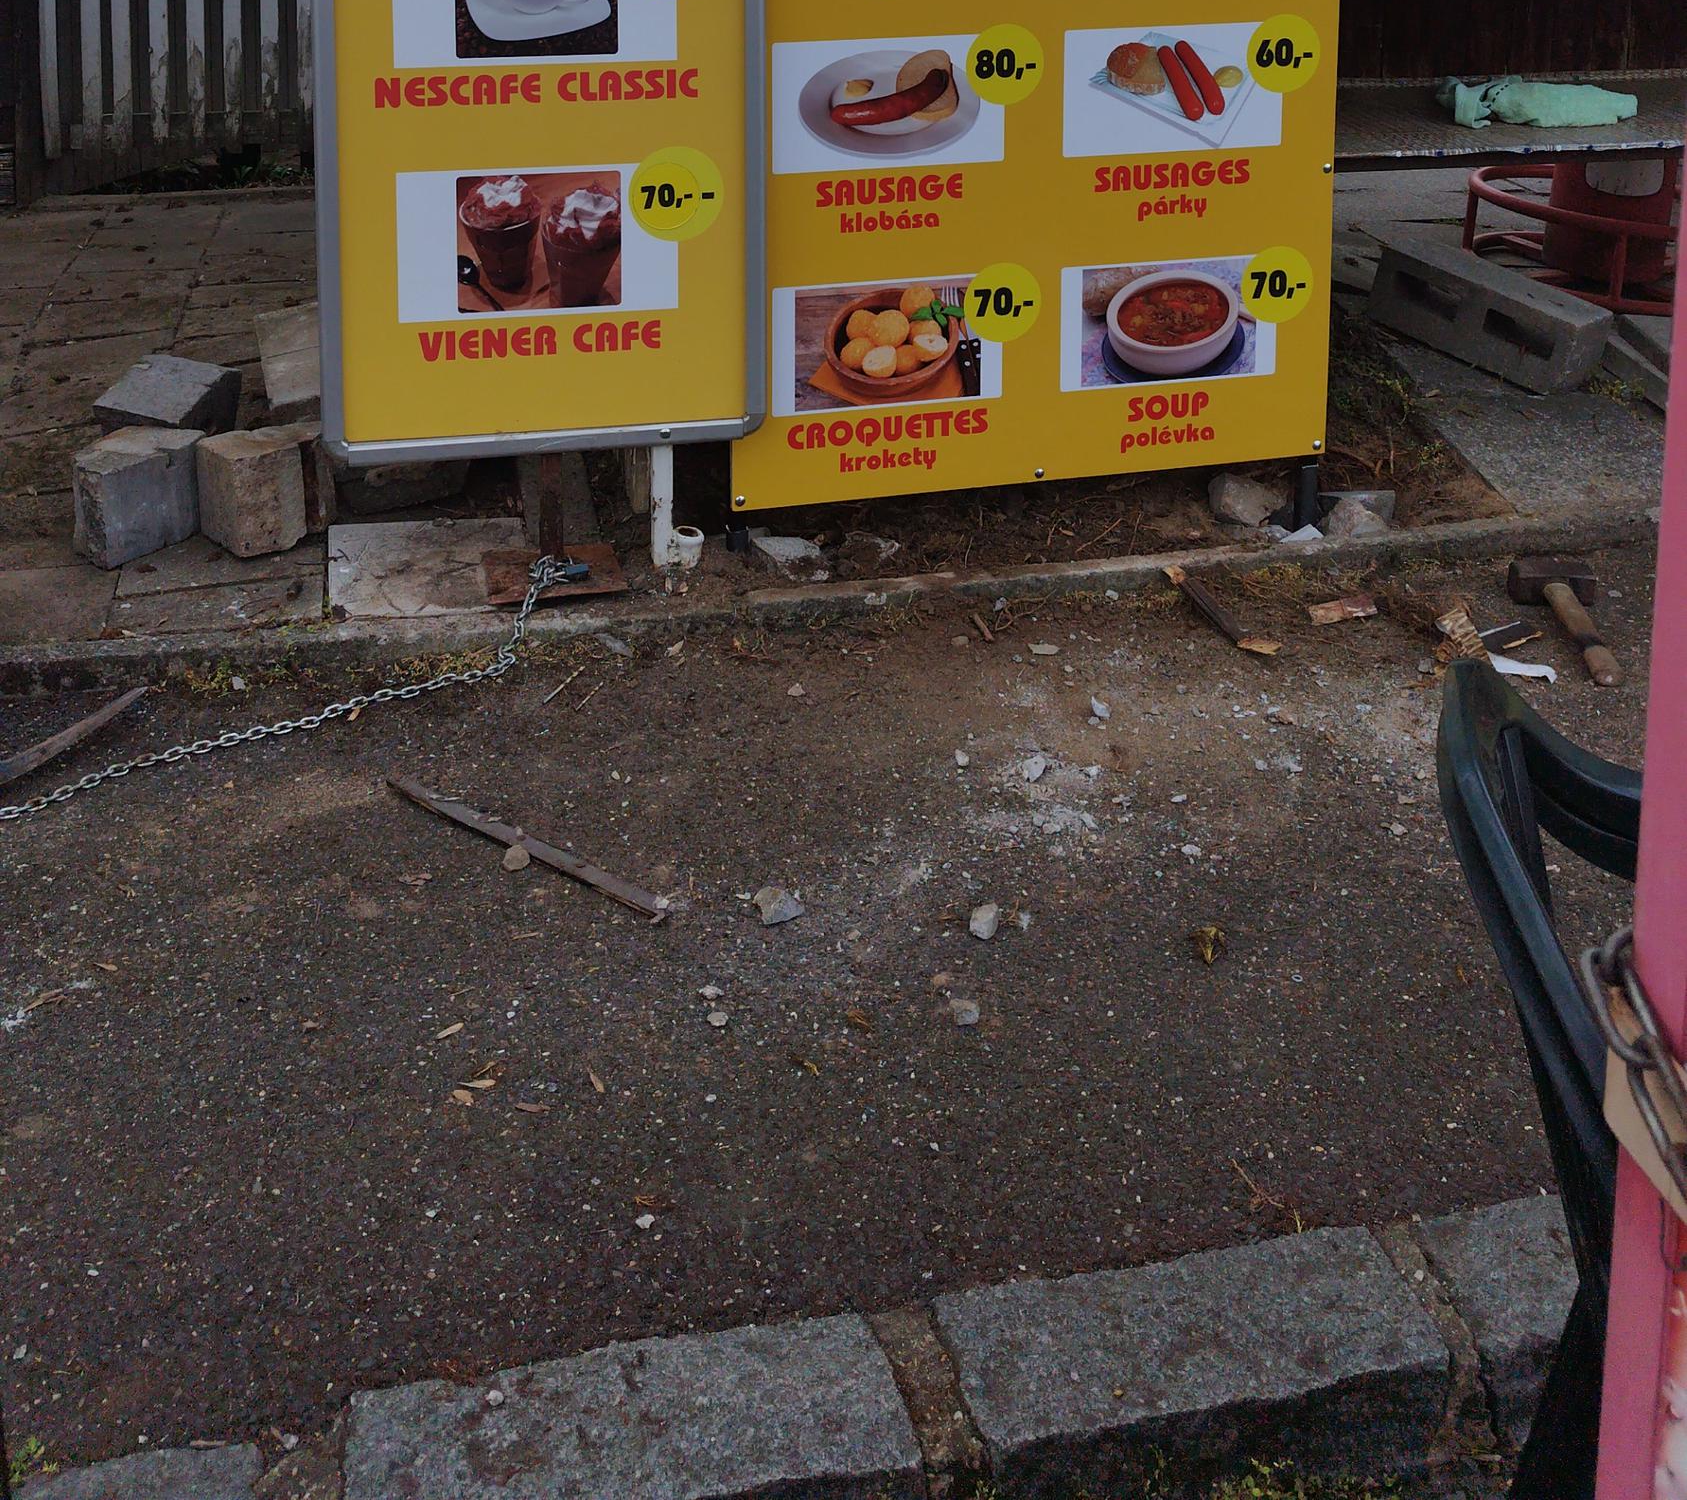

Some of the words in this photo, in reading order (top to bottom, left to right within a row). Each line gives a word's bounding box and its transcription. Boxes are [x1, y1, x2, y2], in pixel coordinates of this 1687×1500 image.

[975, 48, 1037, 80] 80,-
[1255, 37, 1313, 69] 60,-
[374, 73, 541, 109] NESCAFE
[557, 68, 699, 102] CLASSIC
[815, 172, 963, 208] SAUSAGE
[1093, 158, 1250, 194] SAUSAGES
[839, 209, 940, 234] klobása
[1137, 194, 1207, 222] párky
[1250, 269, 1306, 300] 70,-
[973, 286, 1034, 318] 70,-
[418, 325, 557, 362] VIENER
[572, 319, 661, 353] CAFE
[1127, 391, 1210, 423] SOUP
[786, 407, 989, 451] CROQUETTES
[1120, 423, 1215, 454] polévka
[838, 446, 937, 473] krokety
